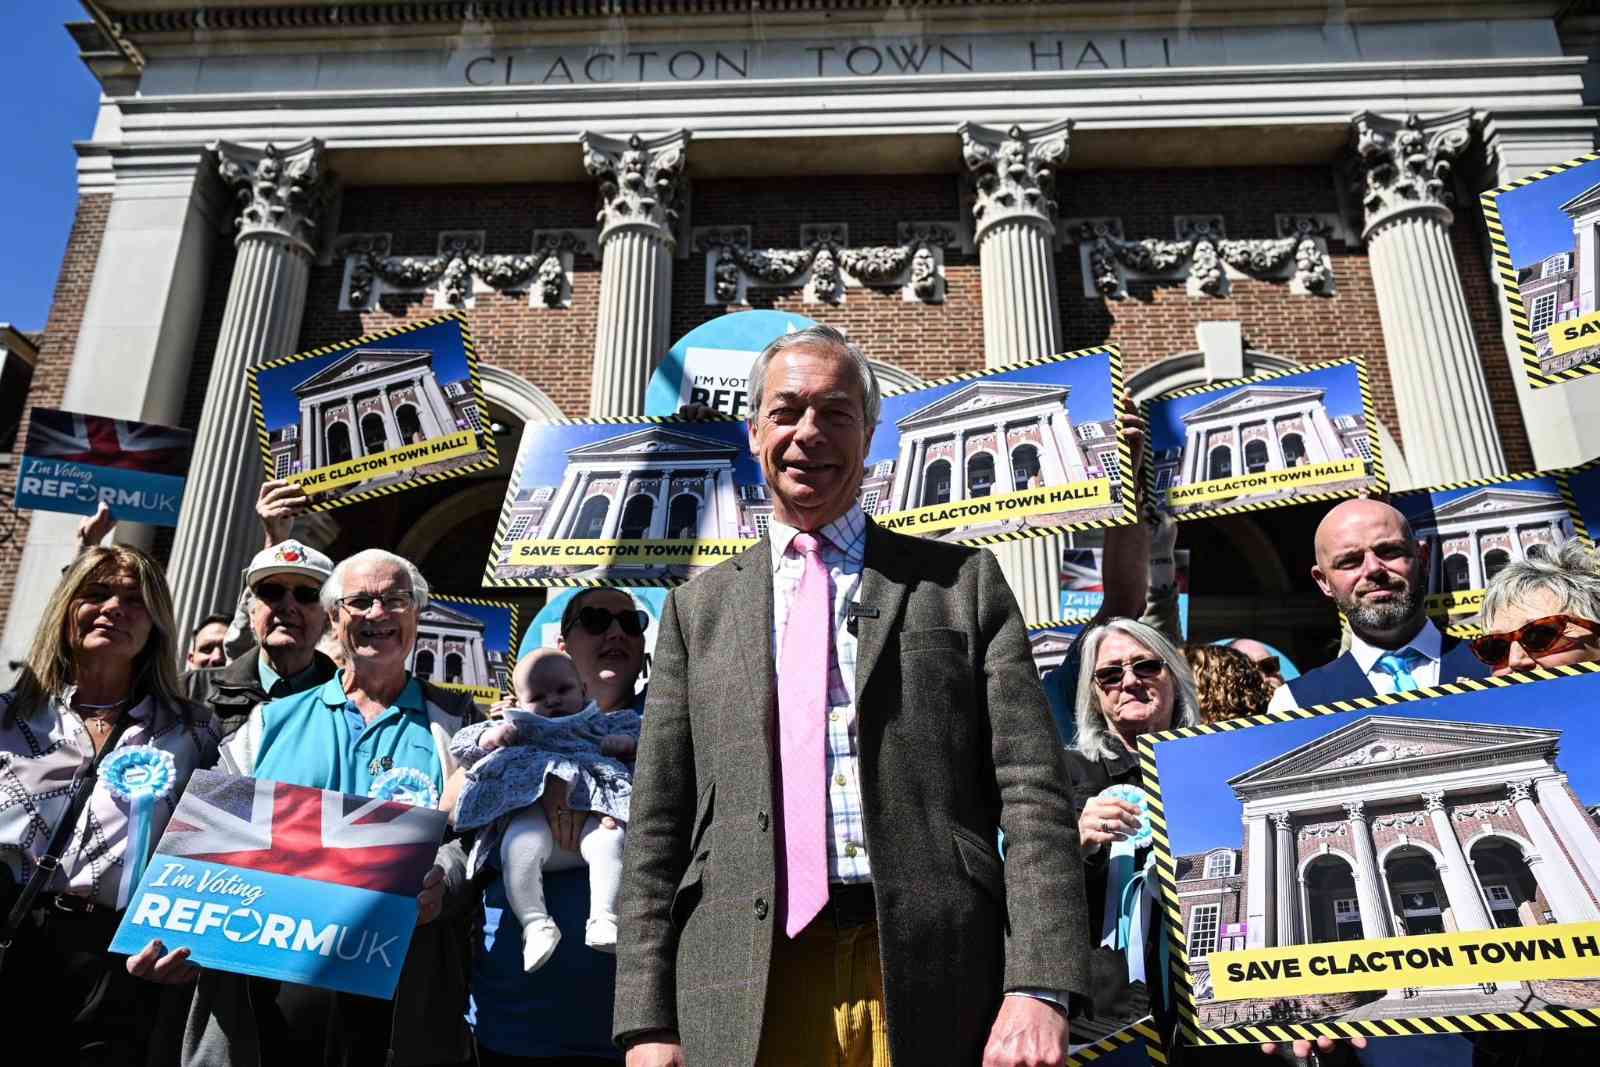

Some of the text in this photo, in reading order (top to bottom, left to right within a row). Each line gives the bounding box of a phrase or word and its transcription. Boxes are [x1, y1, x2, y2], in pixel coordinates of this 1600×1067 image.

[465, 37, 1173, 86] CLACTON TOWN HALL
[694, 375, 714, 386] I'M
[27, 460, 93, 482] I'm Voting
[330, 456, 388, 480] CLACTON
[390, 446, 429, 463] TOWN
[431, 436, 468, 454] HALL!
[1172, 463, 1355, 499] SAVE CLACTON TOWN HALL!
[919, 502, 991, 523] CLACTON
[996, 493, 1045, 511] TOWN
[1050, 485, 1099, 503] HALL!
[519, 545, 561, 556] SAVE
[565, 545, 640, 556] CLACTON
[643, 545, 694, 556] TOWN
[149, 862, 265, 905] I'm Voting
[1227, 958, 1302, 983] SAVE
[1308, 946, 1454, 977] CLACTON
[1459, 937, 1566, 965] TOWN
